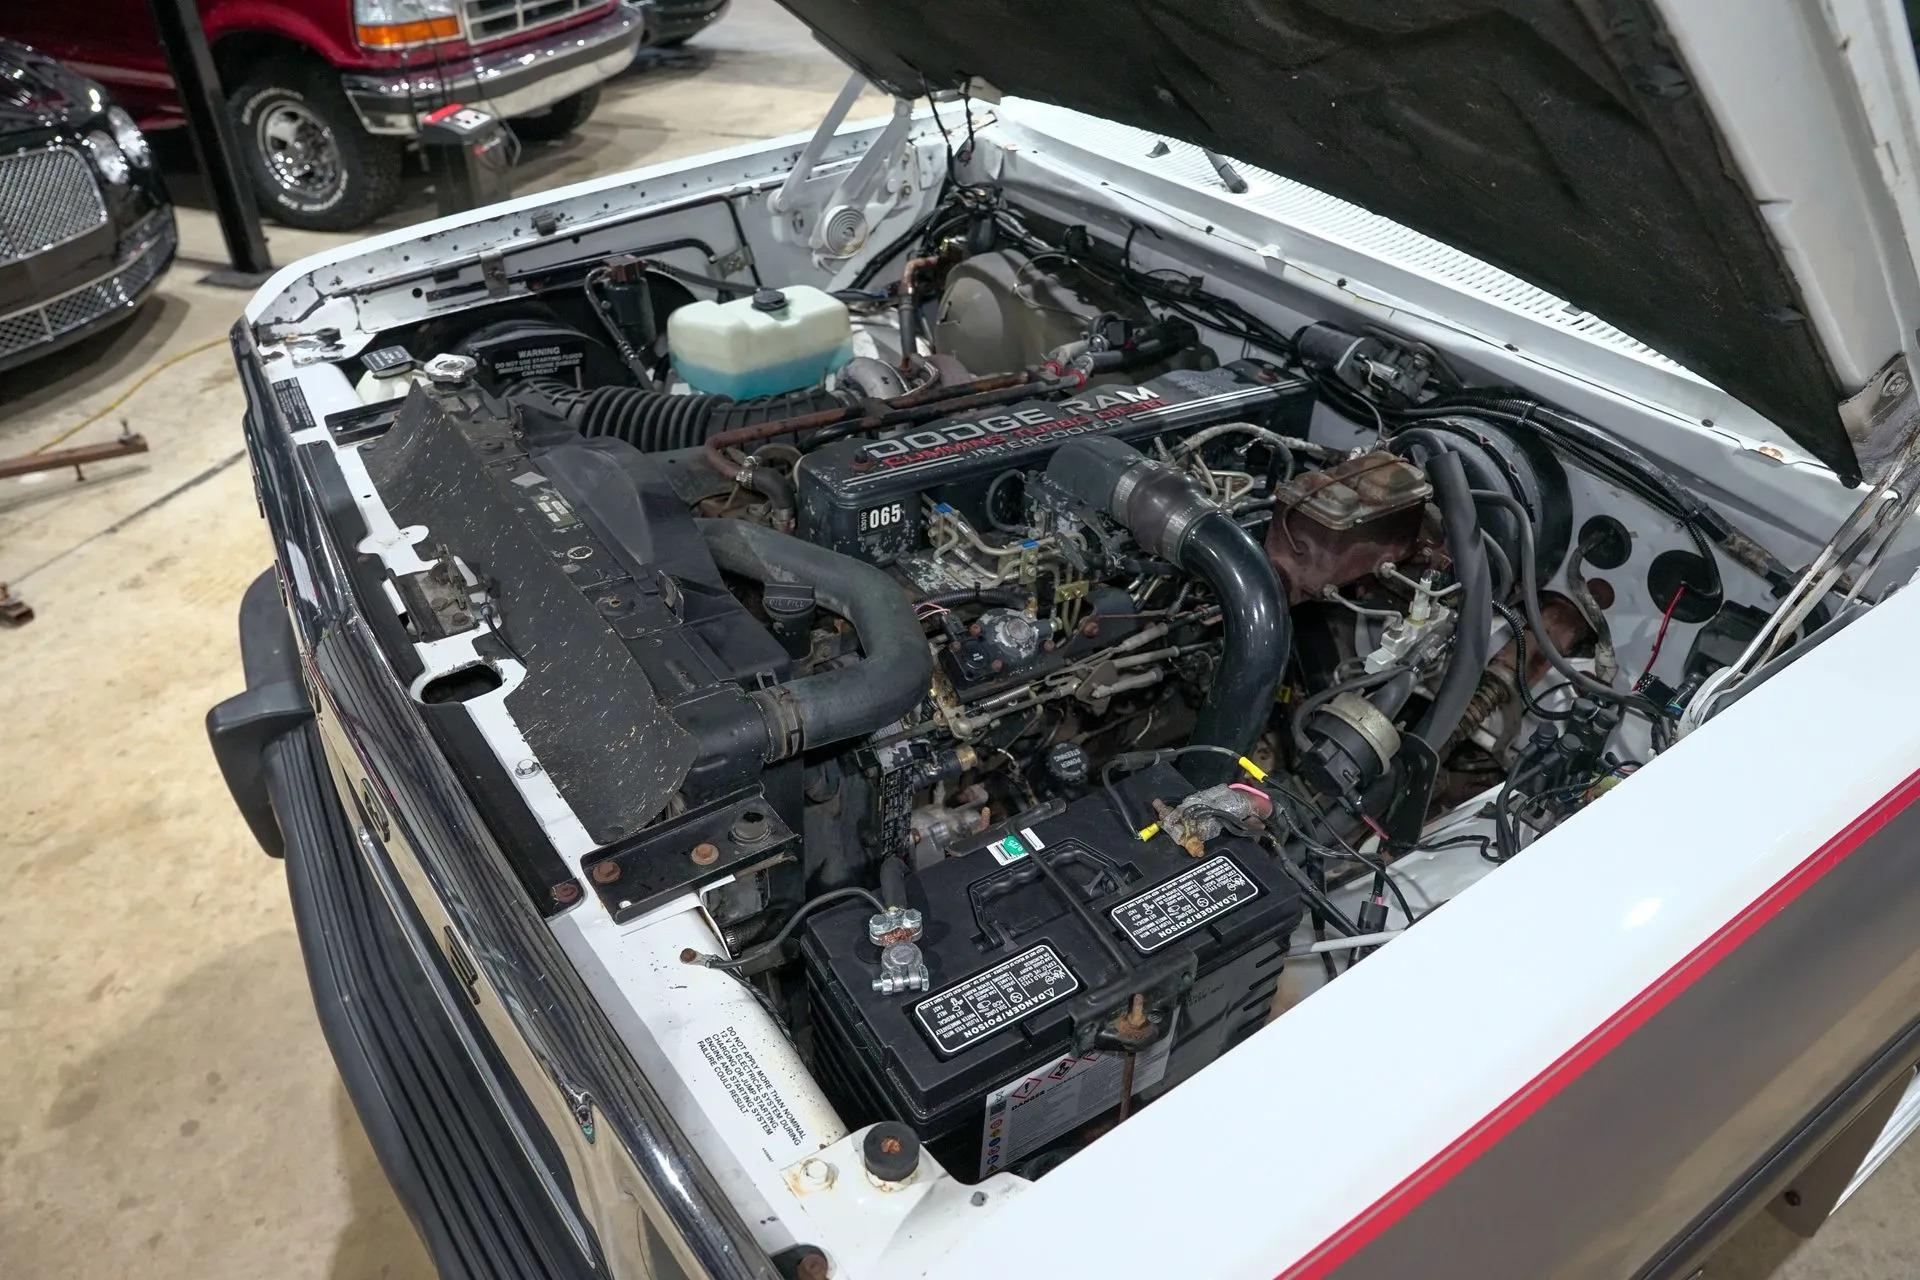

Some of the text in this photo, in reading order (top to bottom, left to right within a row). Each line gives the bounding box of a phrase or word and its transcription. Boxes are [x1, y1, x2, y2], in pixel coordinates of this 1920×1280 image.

[518, 346, 560, 358] WARNING
[863, 386, 1160, 459] DODGE RAM
[883, 400, 1167, 468] CUMMINS TURBO DIESEL
[972, 418, 1122, 458] INTERCOOLED
[870, 503, 901, 529] 065
[1060, 757, 1081, 768] POWER
[1157, 896, 1230, 939] DANGER/POISON
[962, 991, 1046, 1038] DANGER/POISON
[697, 1040, 749, 1116] FAILURE COULD RESULT.
[704, 1036, 724, 1061] ENGINE
[720, 1060, 733, 1075] AND
[729, 1075, 754, 1108] STARTING
[750, 1107, 773, 1136] SYSTEM
[712, 1033, 737, 1066] CHARGING
[733, 1066, 744, 1077] OR
[740, 1077, 756, 1096] JUMP
[752, 1095, 779, 1130] STARTING.
[719, 1030, 728, 1038] 12
[728, 1043, 738, 1053] TO
[735, 1053, 764, 1092] ELECTRICAL
[761, 1092, 783, 1119] SYSTEM
[779, 1118, 801, 1146] DURING
[726, 1026, 807, 1140] DO NOT APPLY MORE THAN NOMINAL
[1012, 1090, 1045, 1111] DANGER
